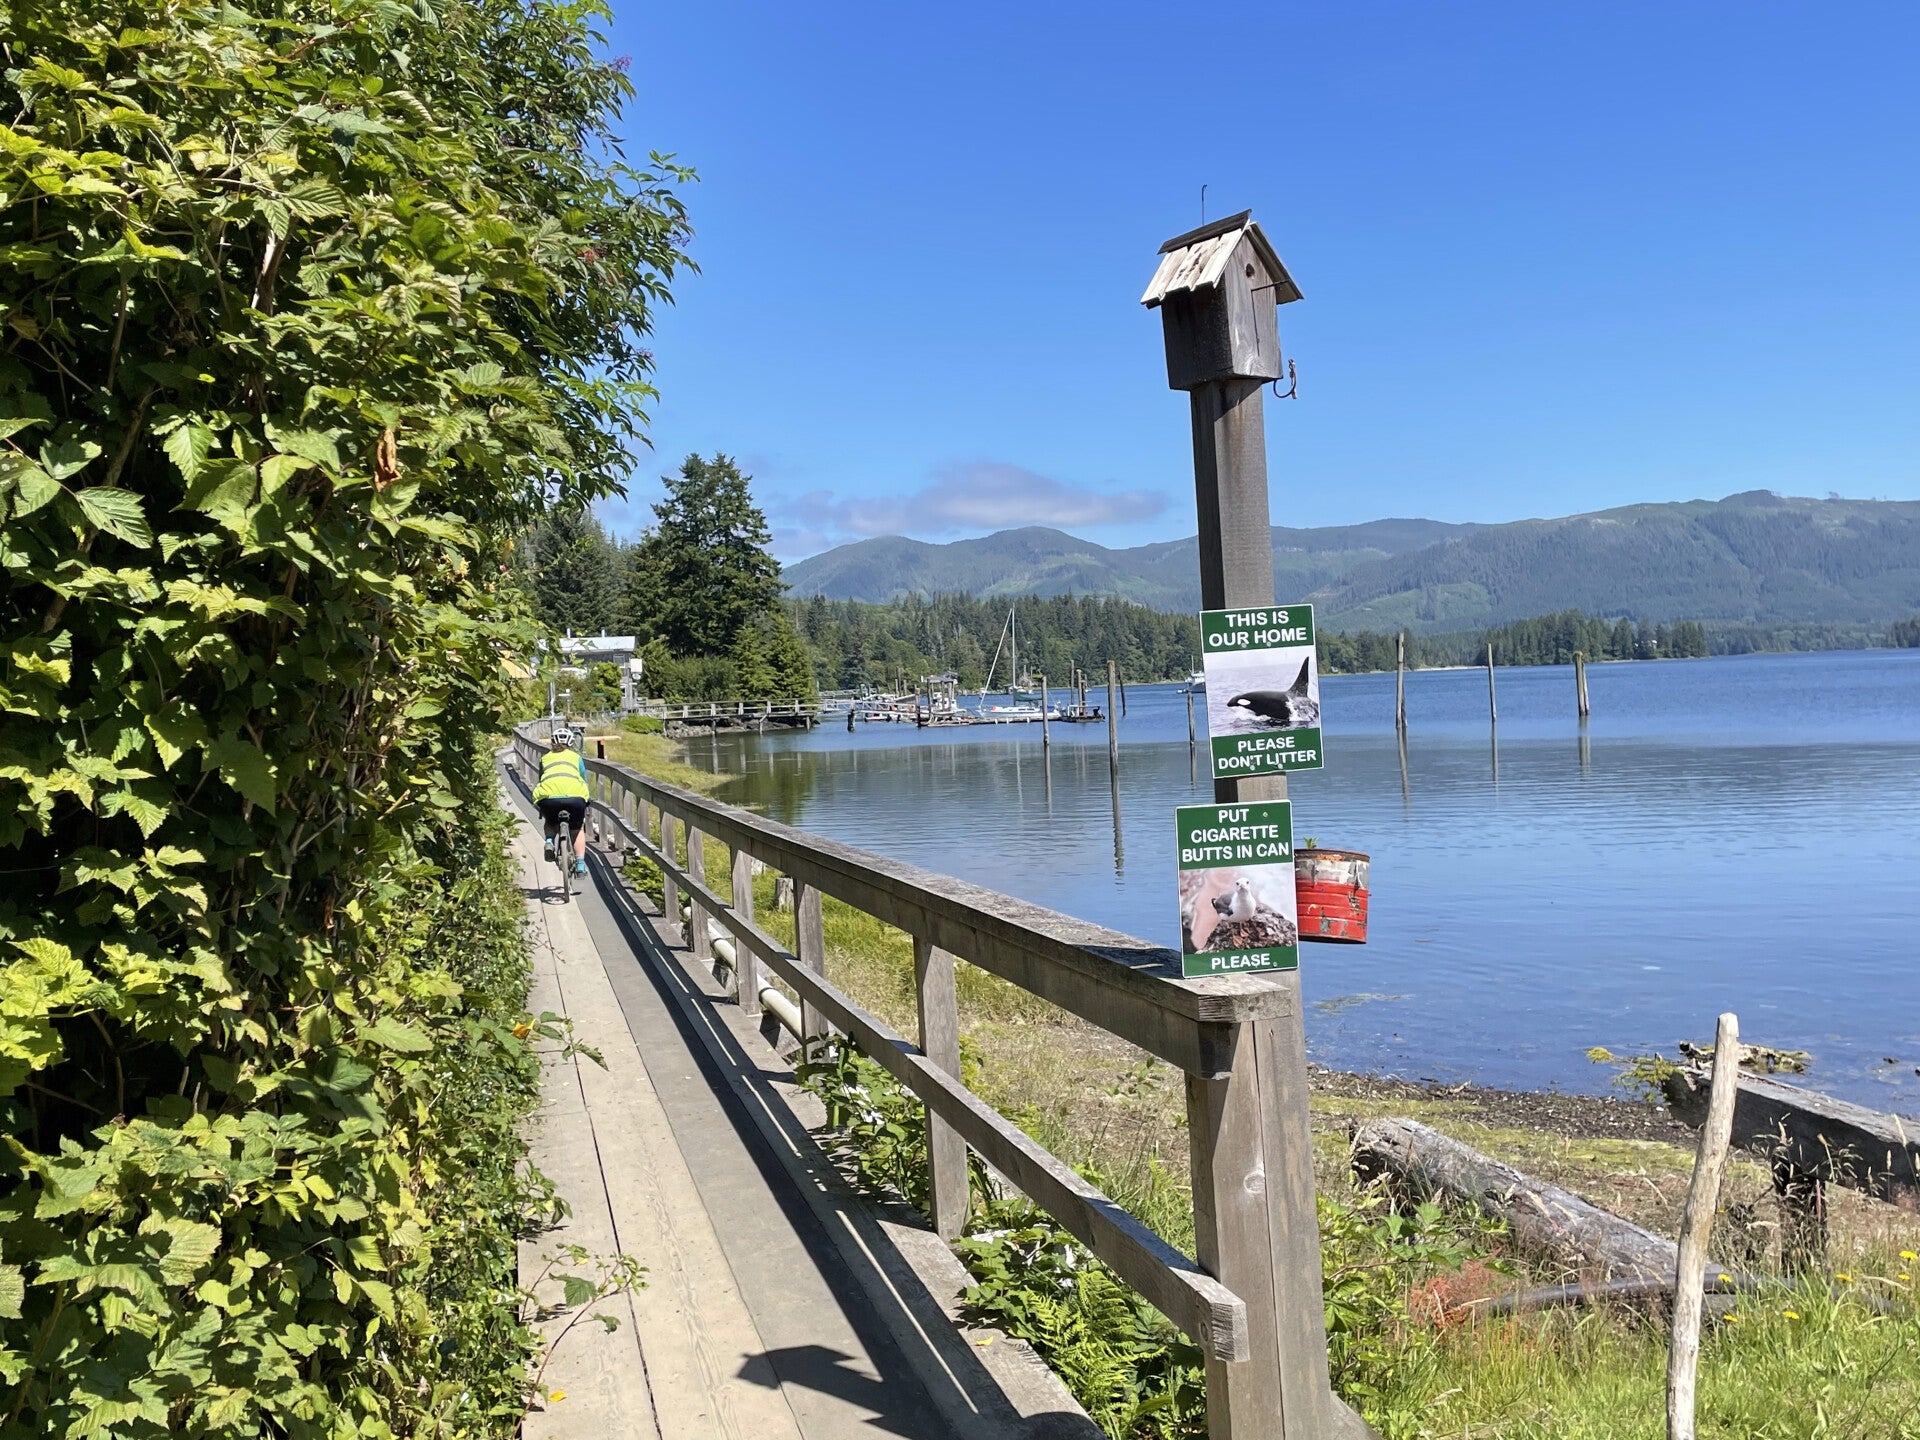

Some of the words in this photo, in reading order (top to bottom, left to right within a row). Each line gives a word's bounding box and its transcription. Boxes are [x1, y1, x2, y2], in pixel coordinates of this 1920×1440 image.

[1225, 612, 1267, 627] THIS
[1272, 610, 1289, 625] IS
[1209, 632, 1249, 647] OUR
[1254, 627, 1307, 644] HOME
[1238, 736, 1295, 752] PLEASE
[1218, 754, 1263, 770] DON'T
[1266, 749, 1317, 765] LITTER
[1218, 808, 1249, 823] PUT
[1190, 824, 1279, 843] CIGARETTE
[1182, 845, 1233, 862] BUTTS
[1236, 844, 1252, 859] IN
[1256, 842, 1289, 858] CAN
[1211, 953, 1270, 970] PLEASE
